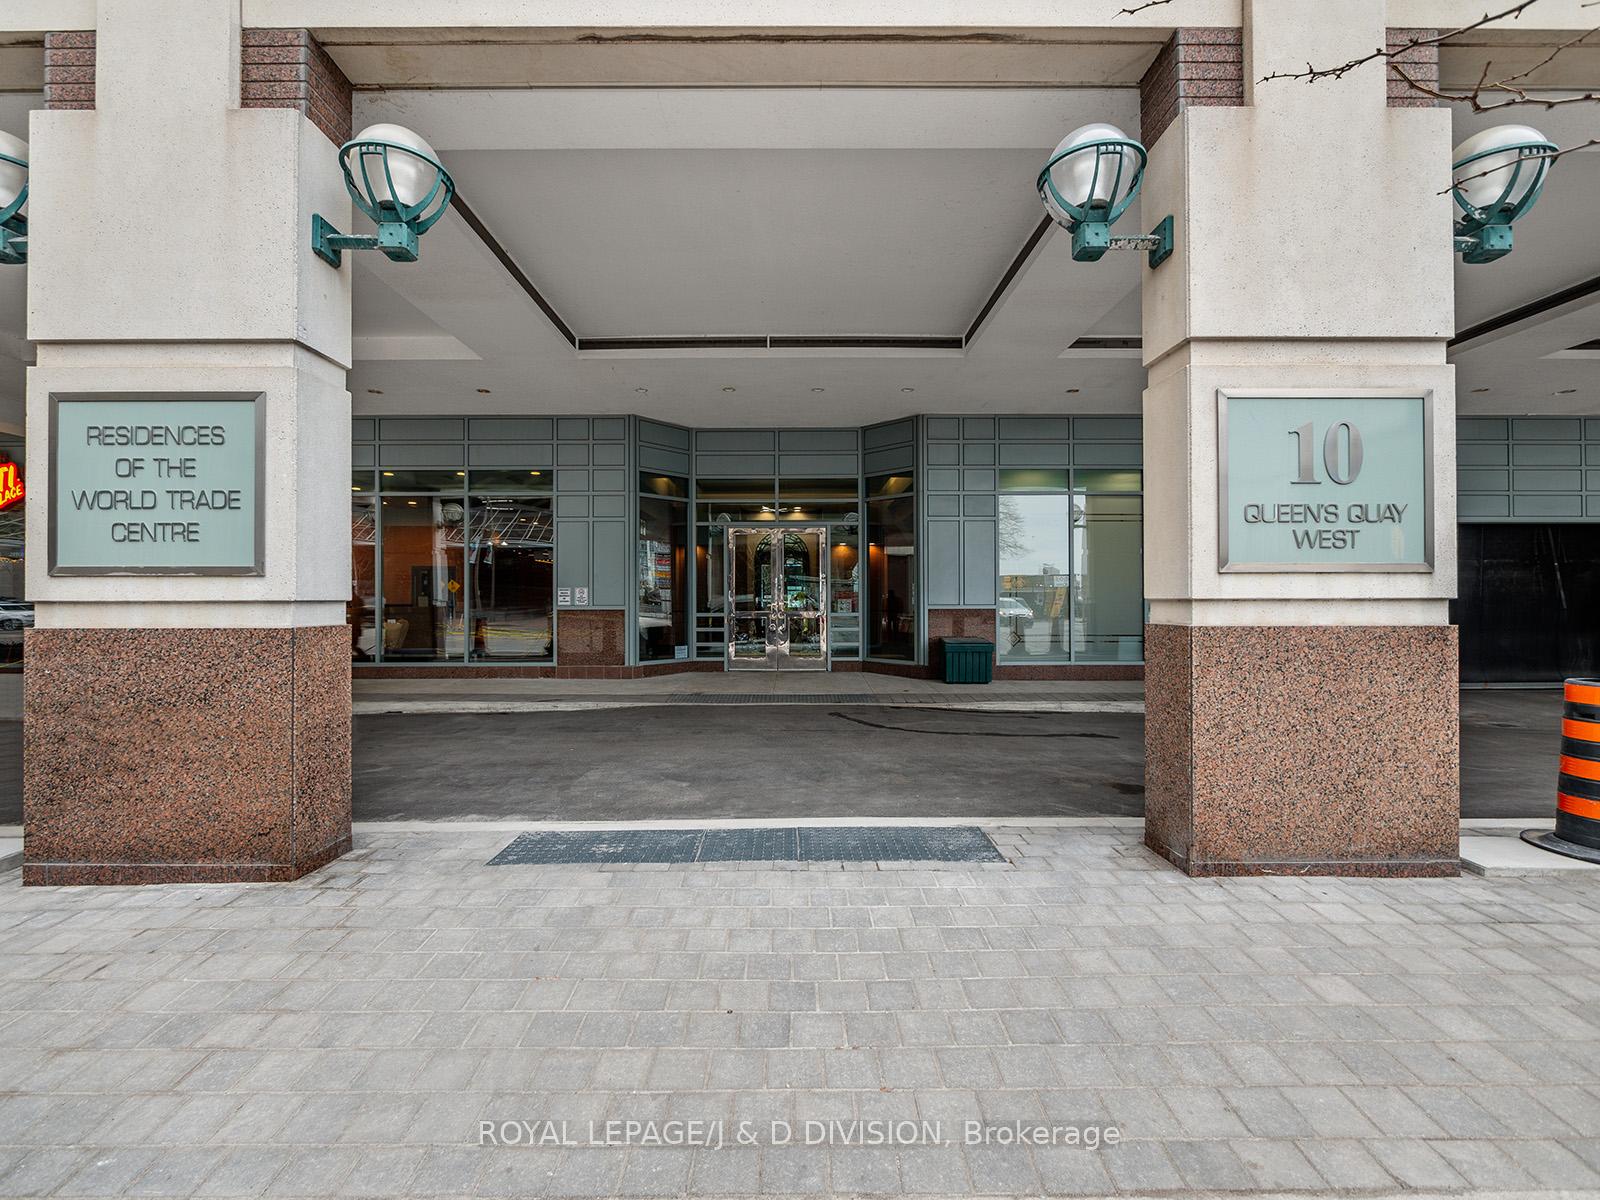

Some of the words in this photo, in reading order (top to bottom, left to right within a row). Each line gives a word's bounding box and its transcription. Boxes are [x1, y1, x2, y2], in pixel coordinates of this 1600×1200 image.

[86, 425, 226, 446] RESIDENCES
[1288, 420, 1364, 485] 10
[115, 458, 145, 478] OF
[153, 458, 197, 478] THE
[71, 490, 157, 510] WORLD
[166, 490, 242, 510] TRADE
[1243, 503, 1340, 524] QUEEN'S
[1347, 503, 1408, 523] QUAY
[111, 522, 200, 543] CENTRE
[1292, 529, 1361, 550] WEST
